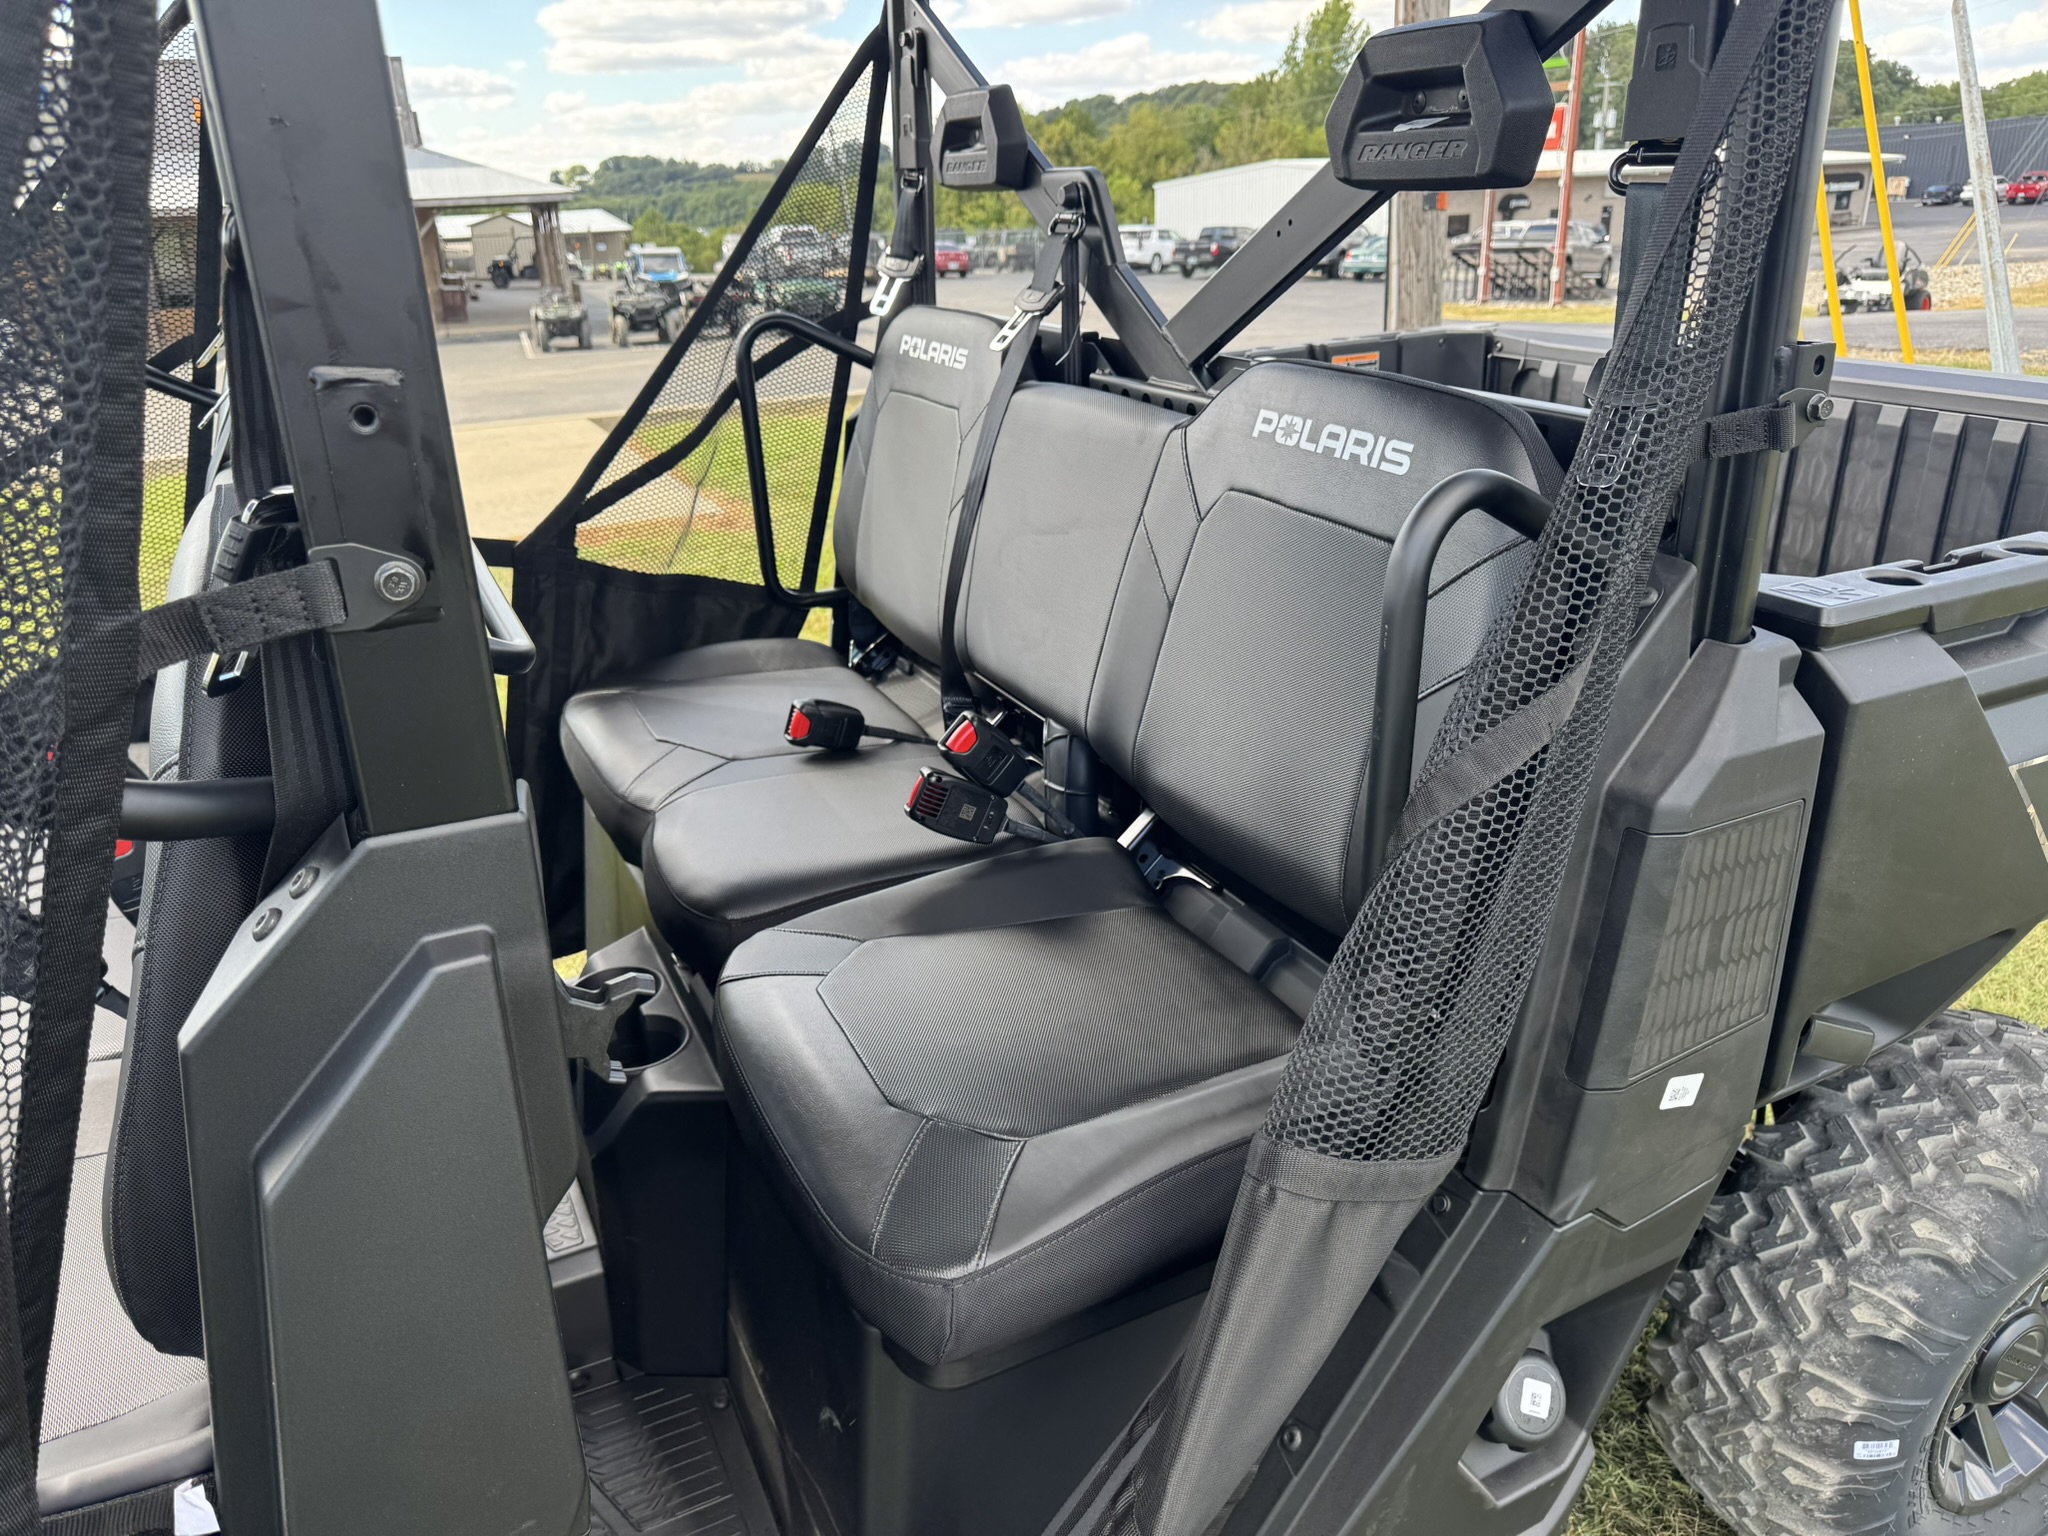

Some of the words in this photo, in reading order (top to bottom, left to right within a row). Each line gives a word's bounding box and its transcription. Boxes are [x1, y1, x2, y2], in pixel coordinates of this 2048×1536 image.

[1357, 138, 1468, 162] RANGER
[945, 159, 987, 174] RANGER
[899, 334, 969, 370] POLARIS
[1251, 408, 1415, 476] POLARIS
